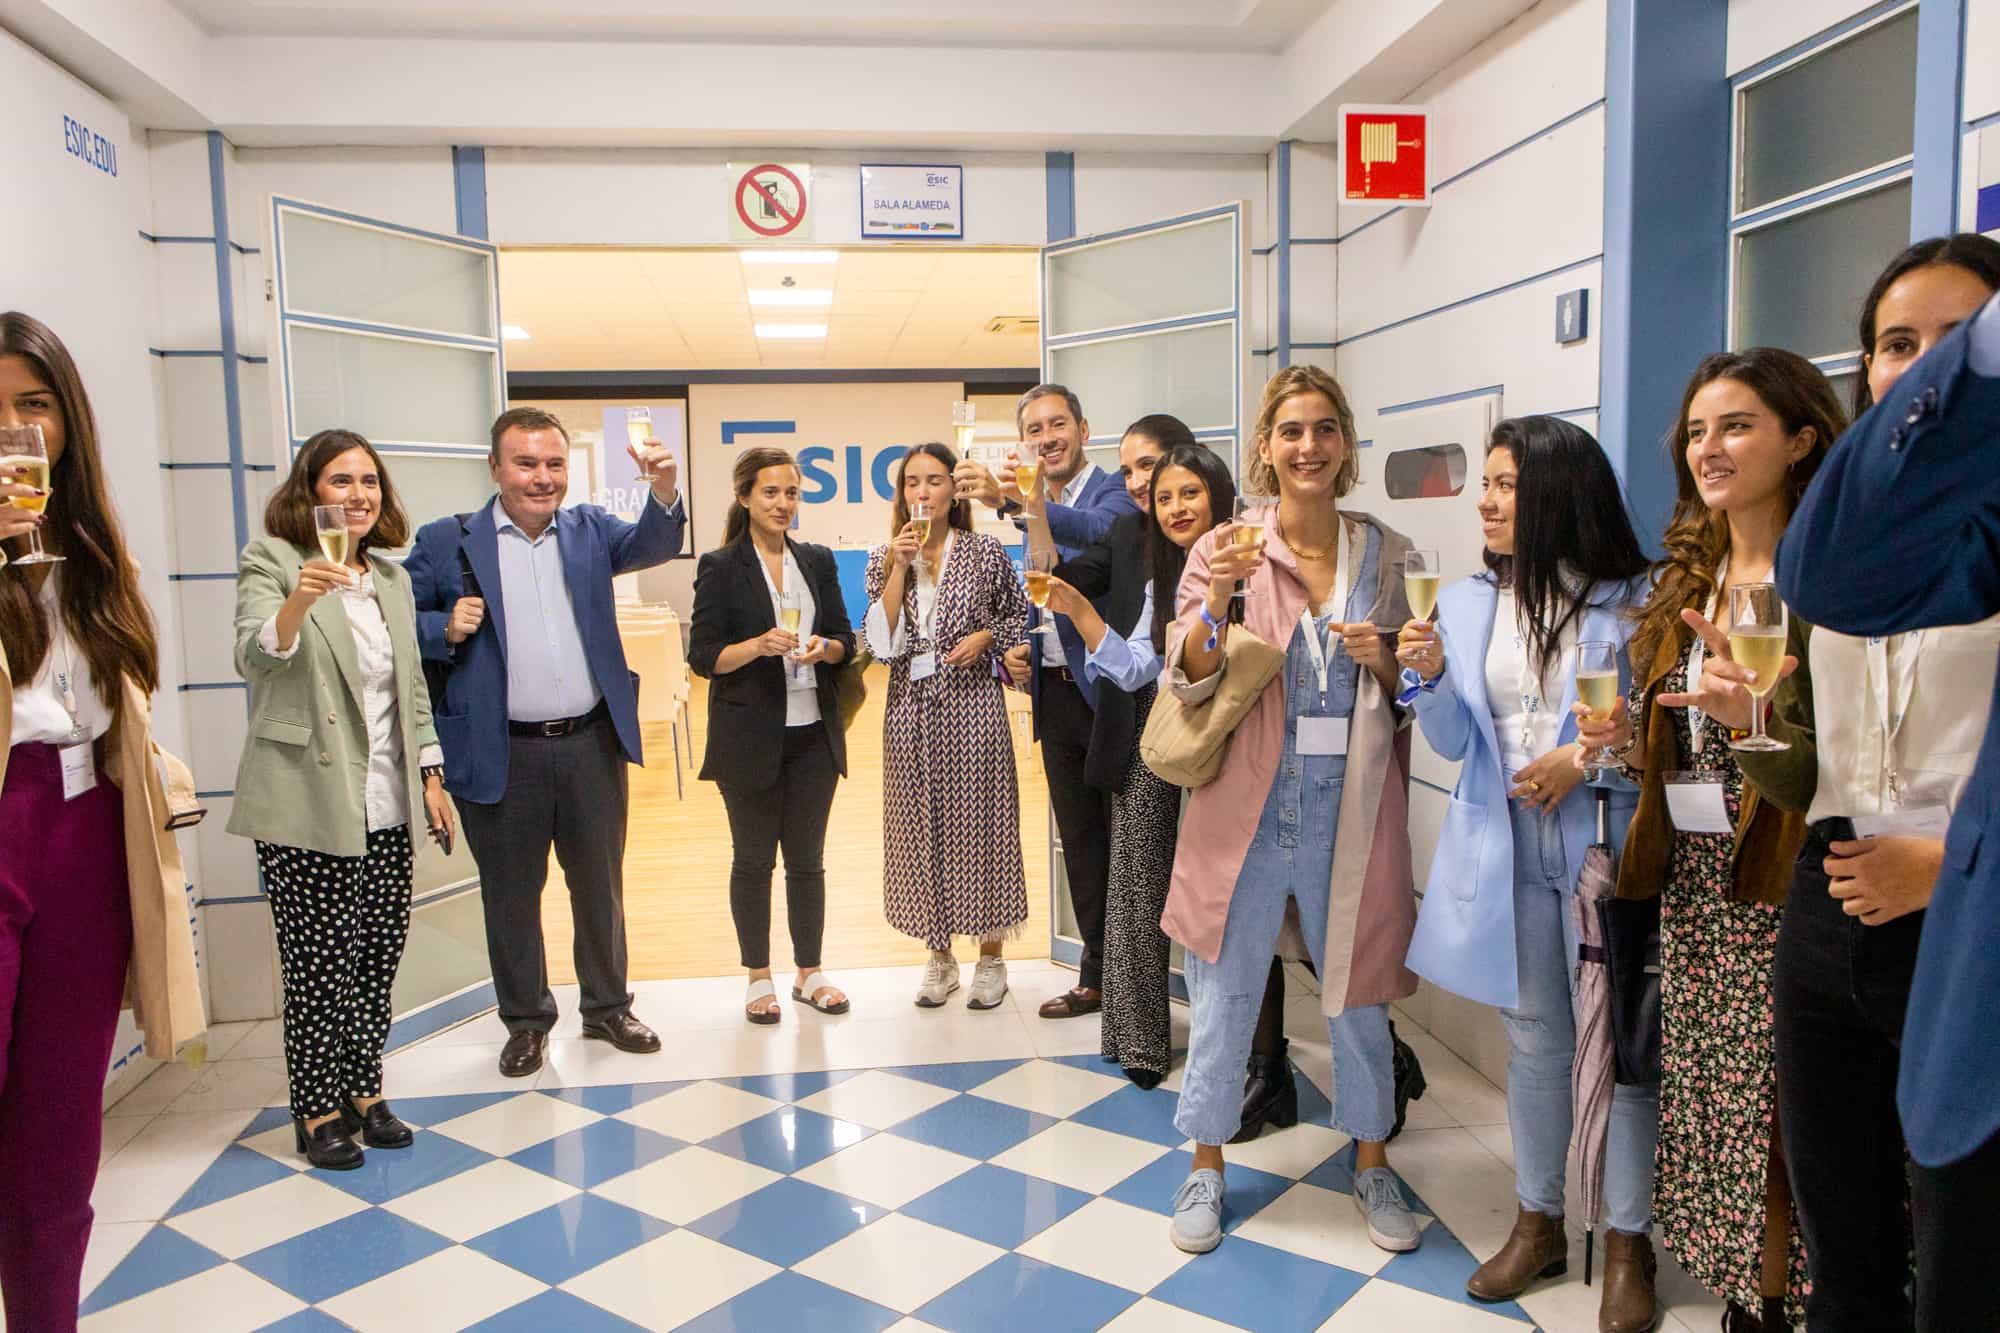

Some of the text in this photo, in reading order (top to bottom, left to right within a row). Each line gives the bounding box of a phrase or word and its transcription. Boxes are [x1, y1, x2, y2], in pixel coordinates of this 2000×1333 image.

[64, 114, 117, 178] ESIC.EDU
[874, 200, 951, 210] SALA ALAMEDA
